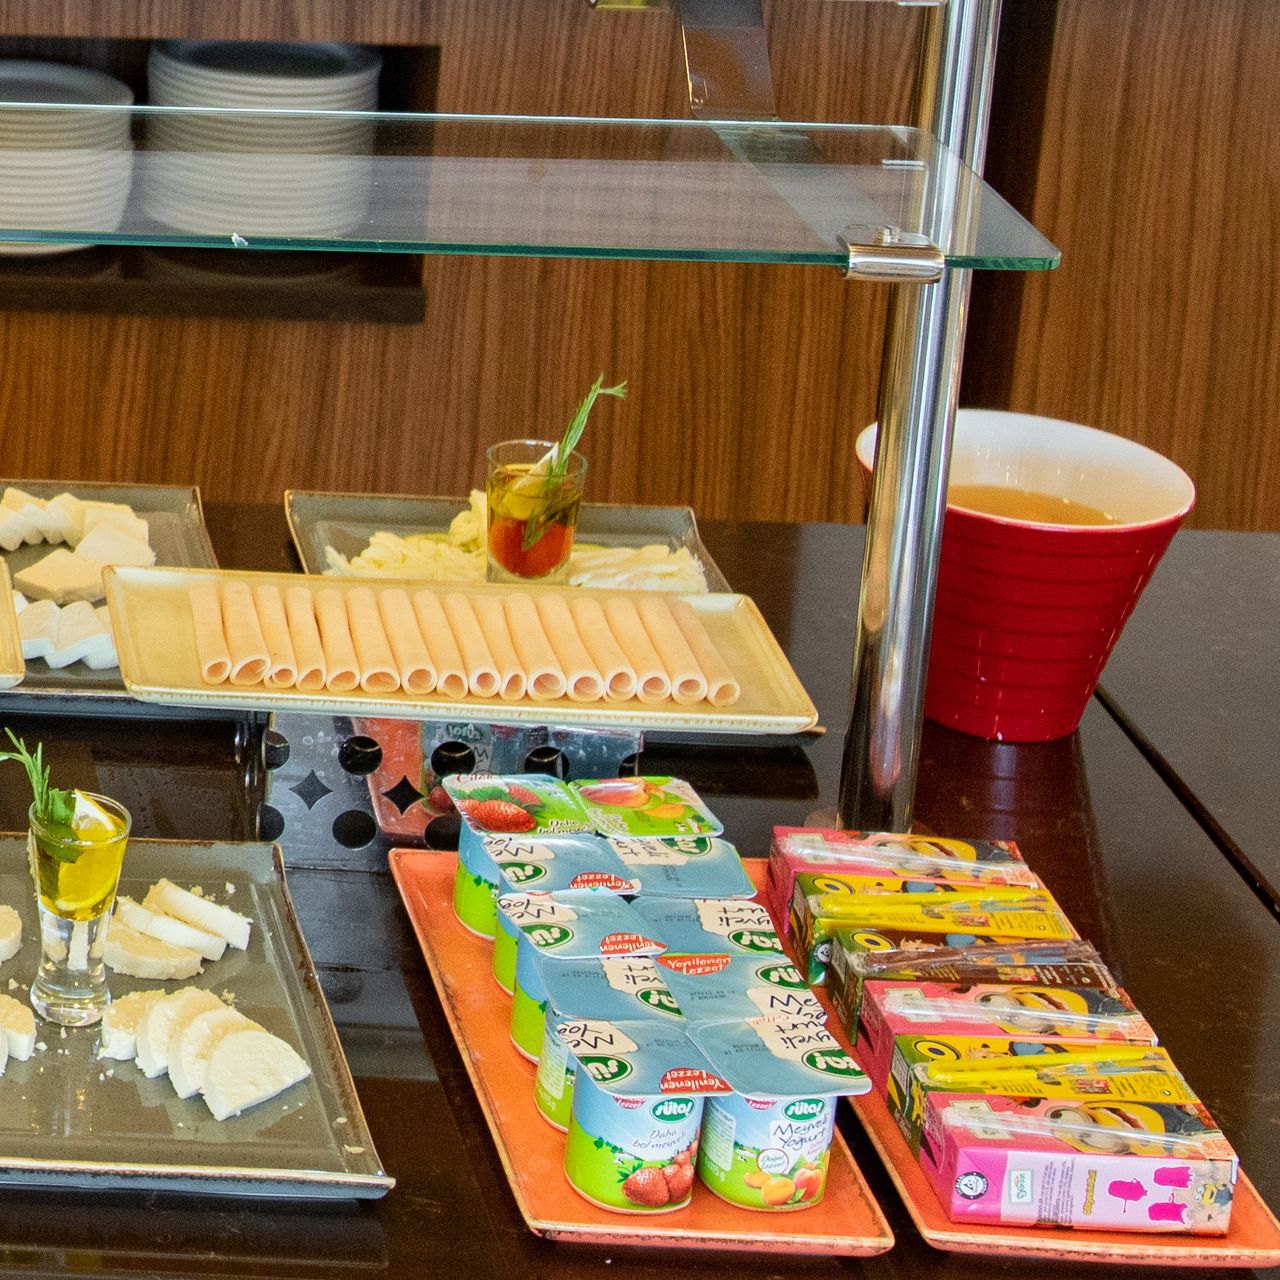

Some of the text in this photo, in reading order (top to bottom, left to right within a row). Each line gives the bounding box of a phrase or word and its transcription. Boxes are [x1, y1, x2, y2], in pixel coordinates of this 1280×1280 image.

[576, 873, 616, 882] Lezzet
[605, 934, 642, 944] Lezzet
[667, 955, 732, 968] Yenilenen
[682, 964, 724, 976] Lezzet
[665, 1070, 708, 1081] Lezzet
[660, 1078, 726, 1090] Yenilenen
